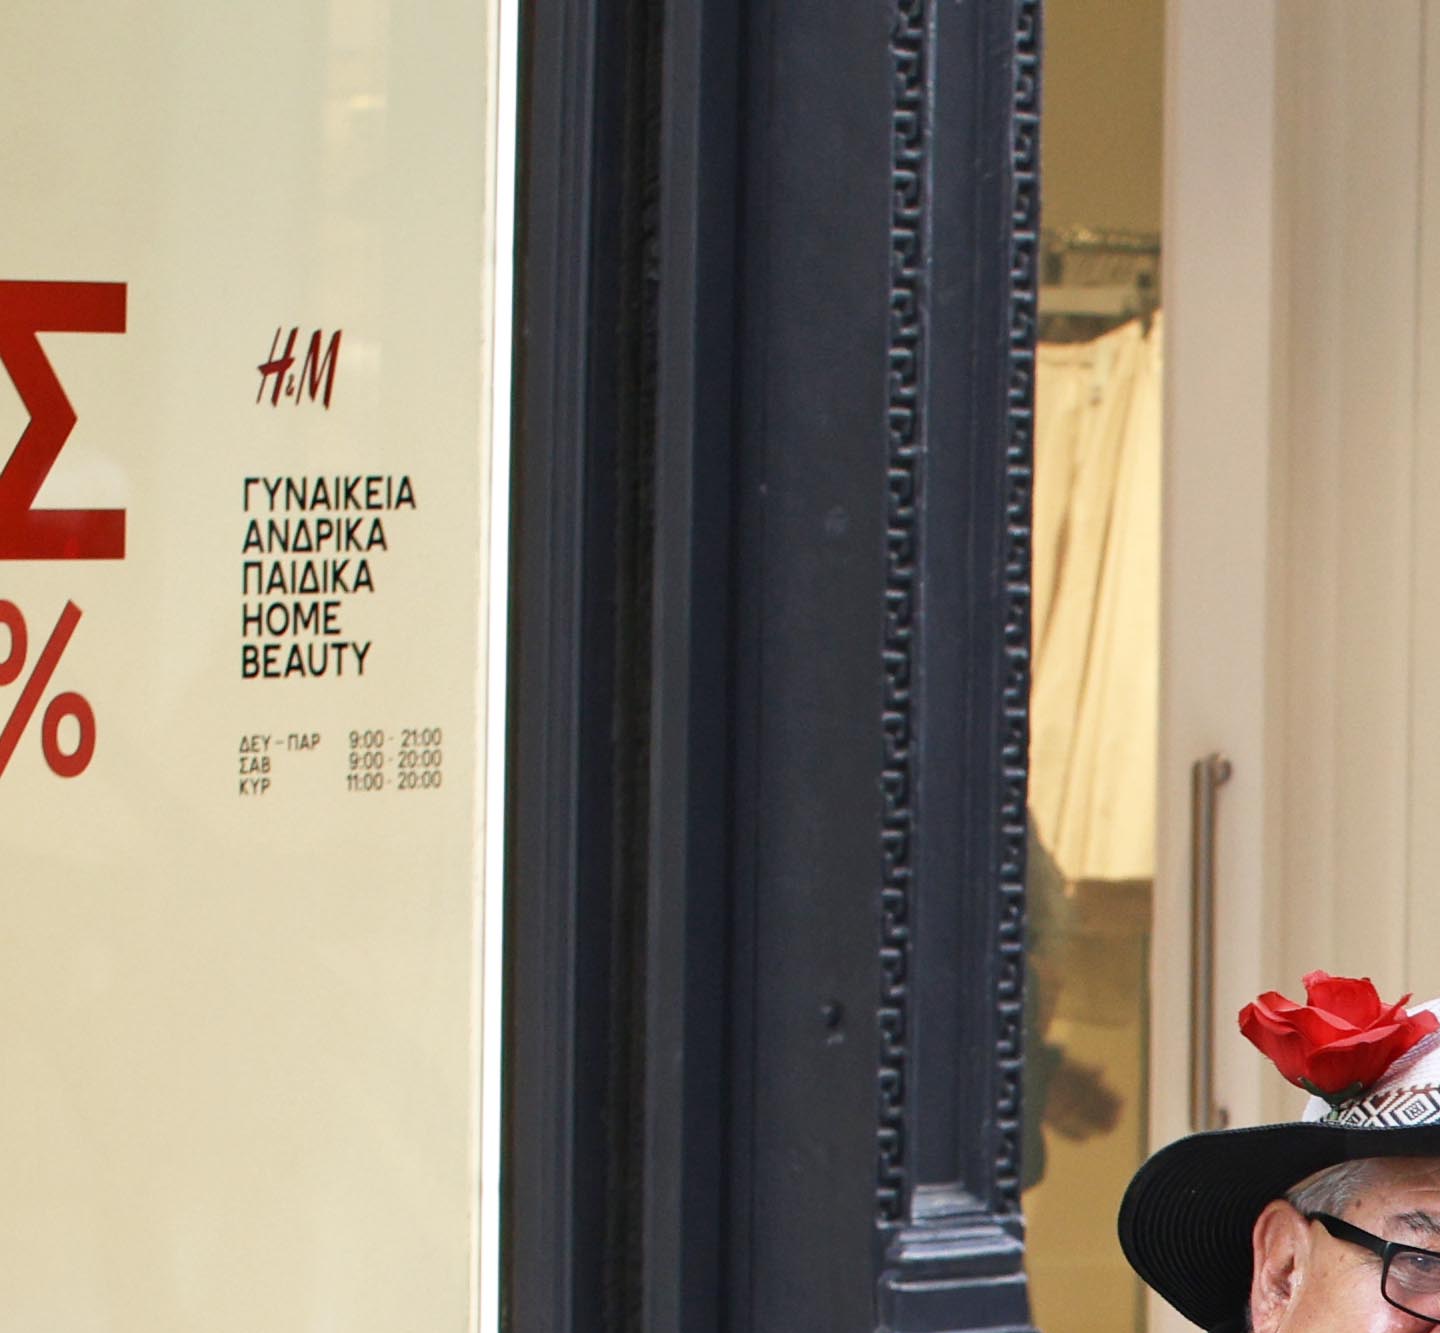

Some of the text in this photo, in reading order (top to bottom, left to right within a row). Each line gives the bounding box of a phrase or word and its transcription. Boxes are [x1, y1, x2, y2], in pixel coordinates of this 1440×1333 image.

[257, 327, 342, 409] H&M
[243, 476, 416, 511] ΓΥΝΑΙΚΕΙΑ
[242, 518, 387, 553] ΑΝΔΡΙΚΑ
[242, 560, 374, 595] ΠΑΙΔΙΚΑ
[242, 601, 341, 637] HOME
[242, 642, 371, 678] BEAUTY
[287, 733, 321, 751] ΠΑΡ
[348, 730, 384, 750] 9:00
[400, 727, 443, 748] 21:00
[239, 756, 271, 774] ΣΑΒ
[348, 751, 384, 771] 9:00
[397, 749, 442, 769] 20:00
[239, 778, 271, 795] ΚΥΡ
[346, 772, 384, 792] 11:00
[397, 770, 442, 790] 20:00
